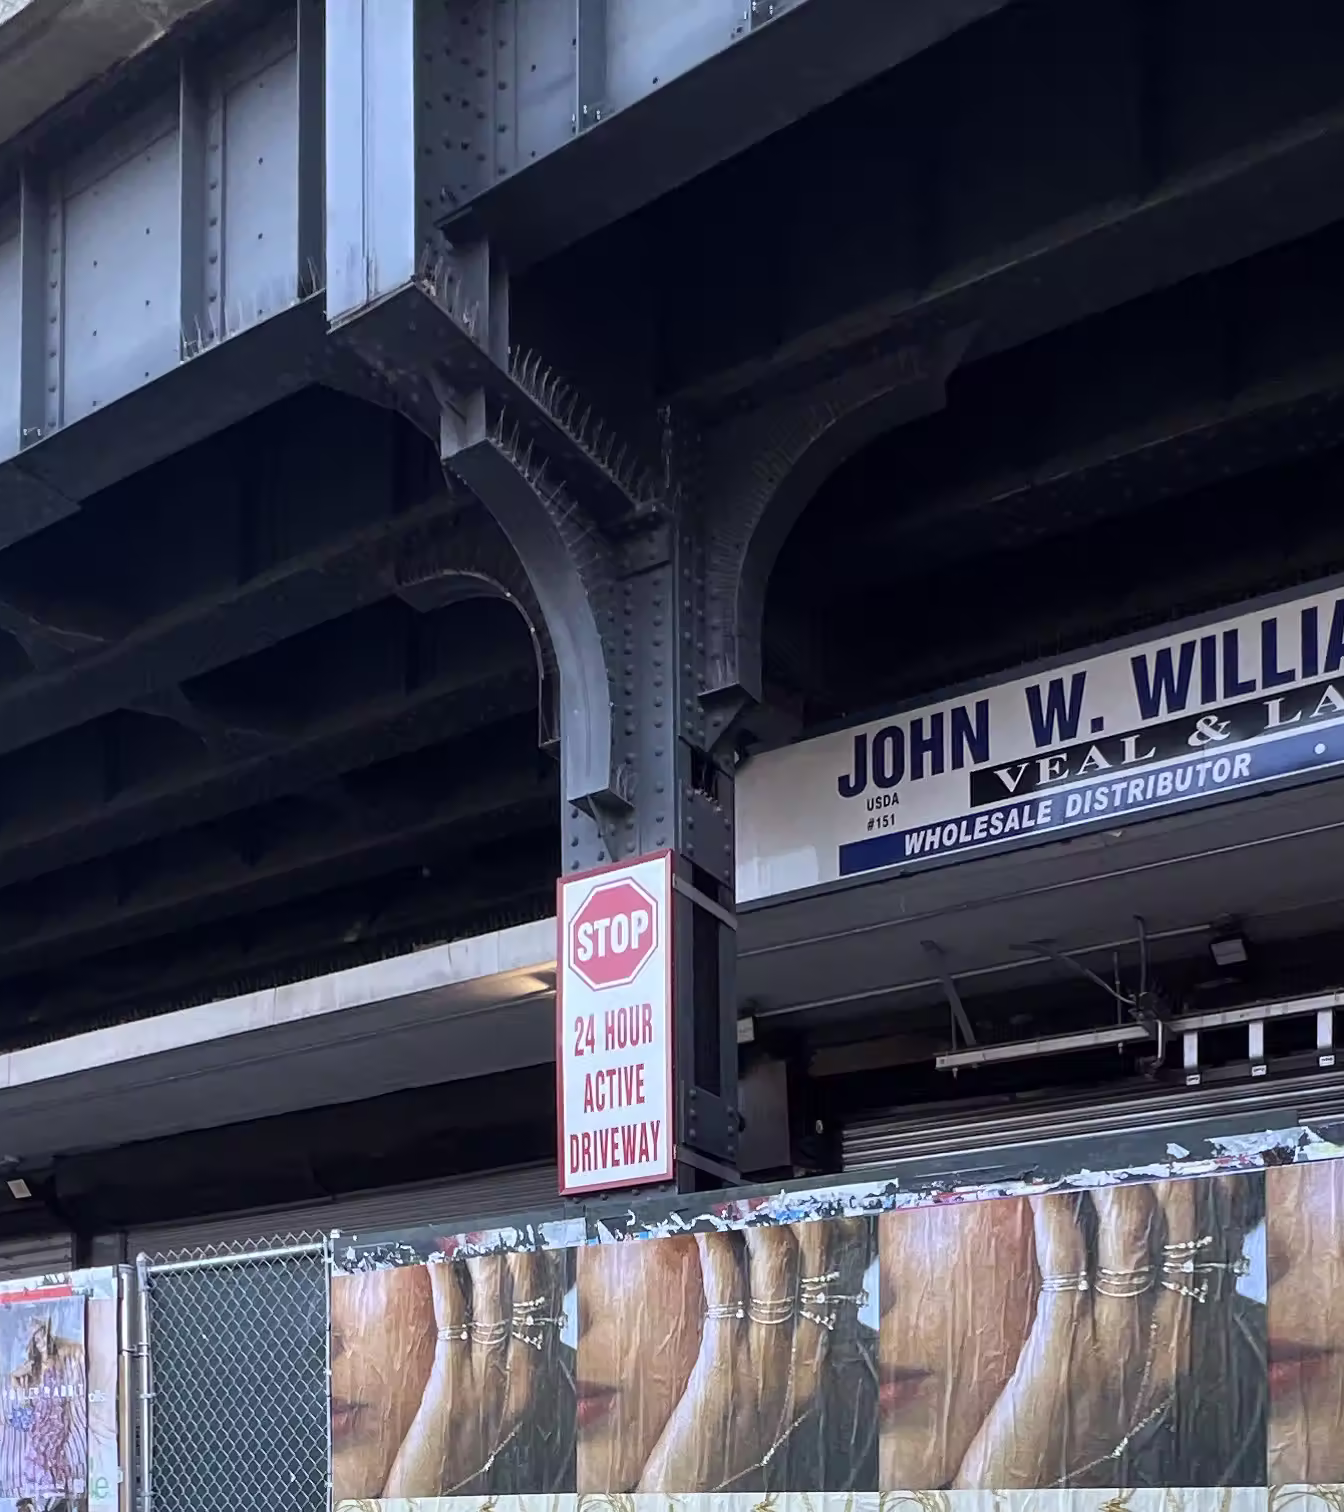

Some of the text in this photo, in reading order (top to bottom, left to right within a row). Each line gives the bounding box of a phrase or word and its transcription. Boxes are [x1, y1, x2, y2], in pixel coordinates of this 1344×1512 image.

[837, 698, 990, 798] JOHN
[1024, 670, 1104, 748] W.
[993, 734, 1157, 793] VEAL
[1187, 715, 1231, 747] &
[866, 791, 900, 811] USDA
[866, 813, 896, 831] #151
[904, 799, 1052, 856] WHOLESALE
[1064, 752, 1252, 819] DISTRIBUTOR
[576, 908, 650, 963] STOP
[573, 1002, 653, 1057] 24 HOUR
[583, 1063, 646, 1114] ACTIVE
[569, 1119, 661, 1175] DRIVEWAY
